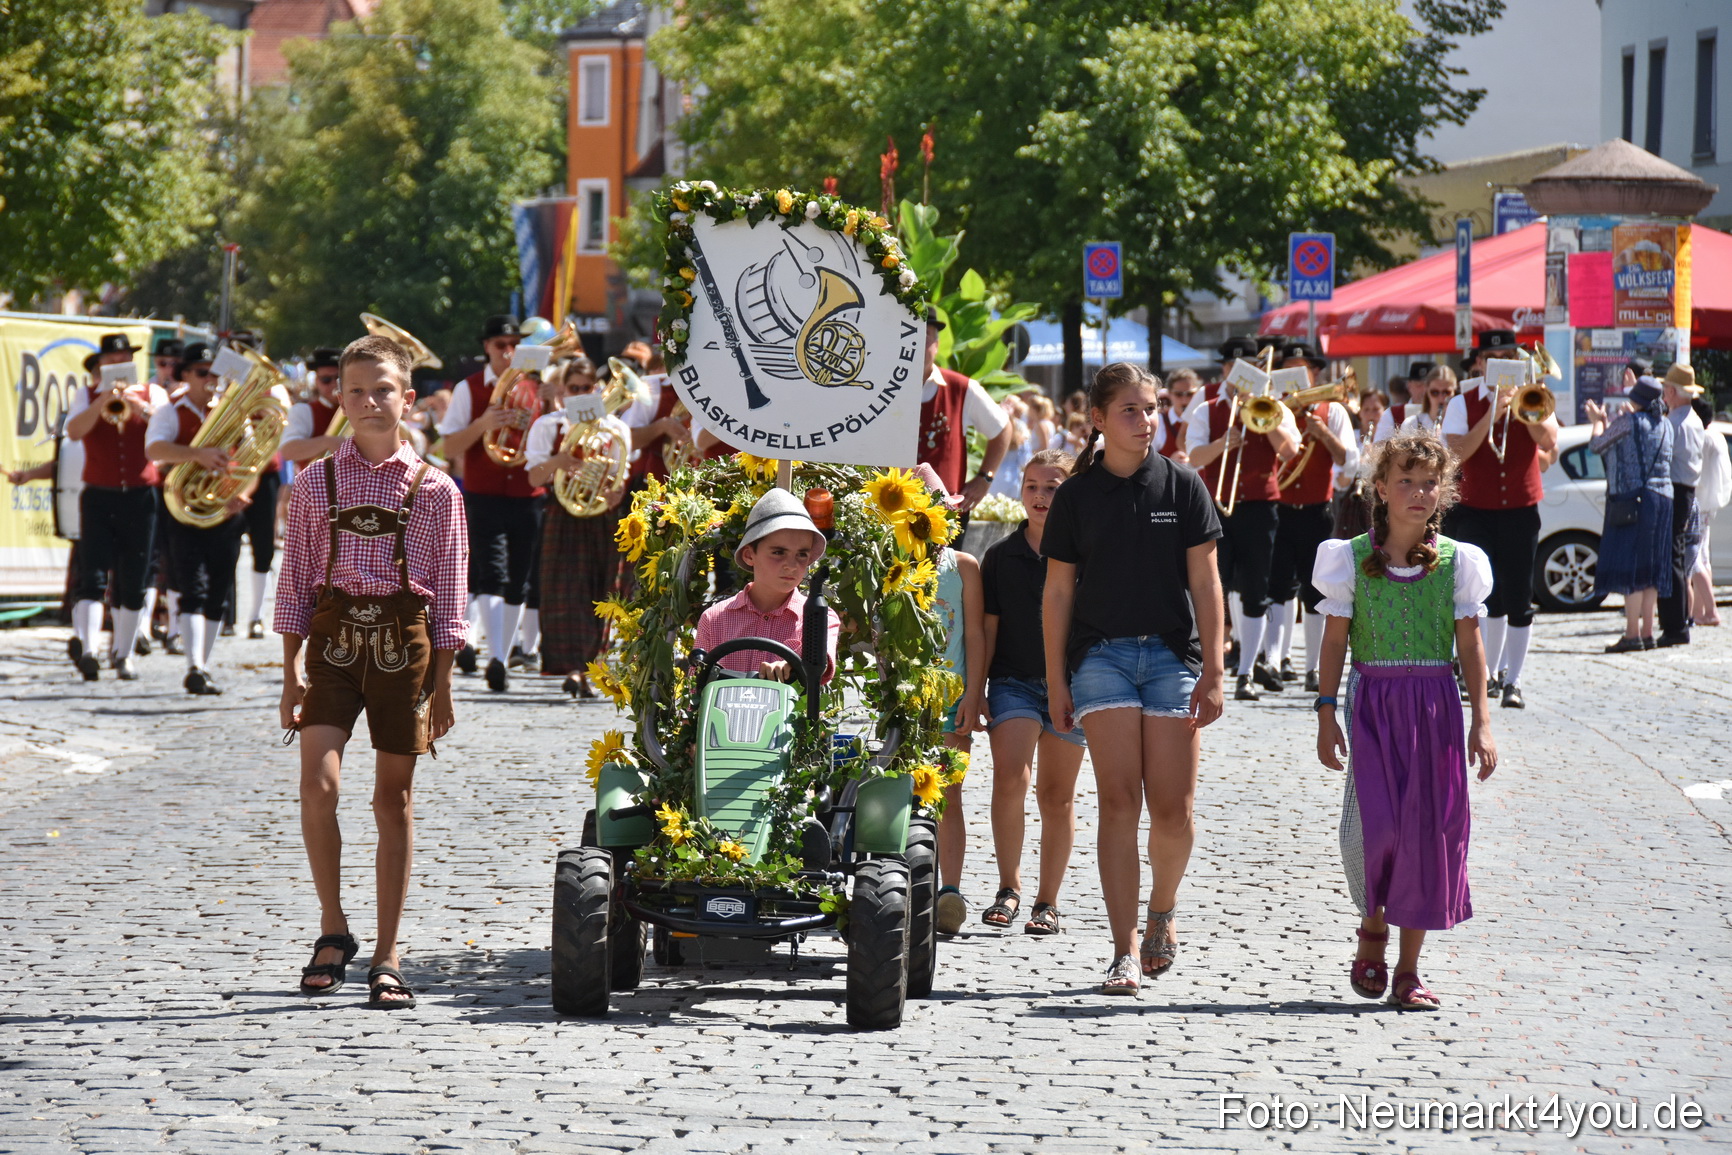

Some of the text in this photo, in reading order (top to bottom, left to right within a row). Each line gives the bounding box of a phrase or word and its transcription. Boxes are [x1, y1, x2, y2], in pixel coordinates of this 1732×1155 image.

[1090, 280, 1119, 293] TAXI
[1618, 270, 1672, 288] VOLKSFEST
[1294, 280, 1329, 296] TAXI
[678, 316, 919, 450] BLASKAPELLE PÖLLING E.V.
[708, 903, 743, 912] BERG
